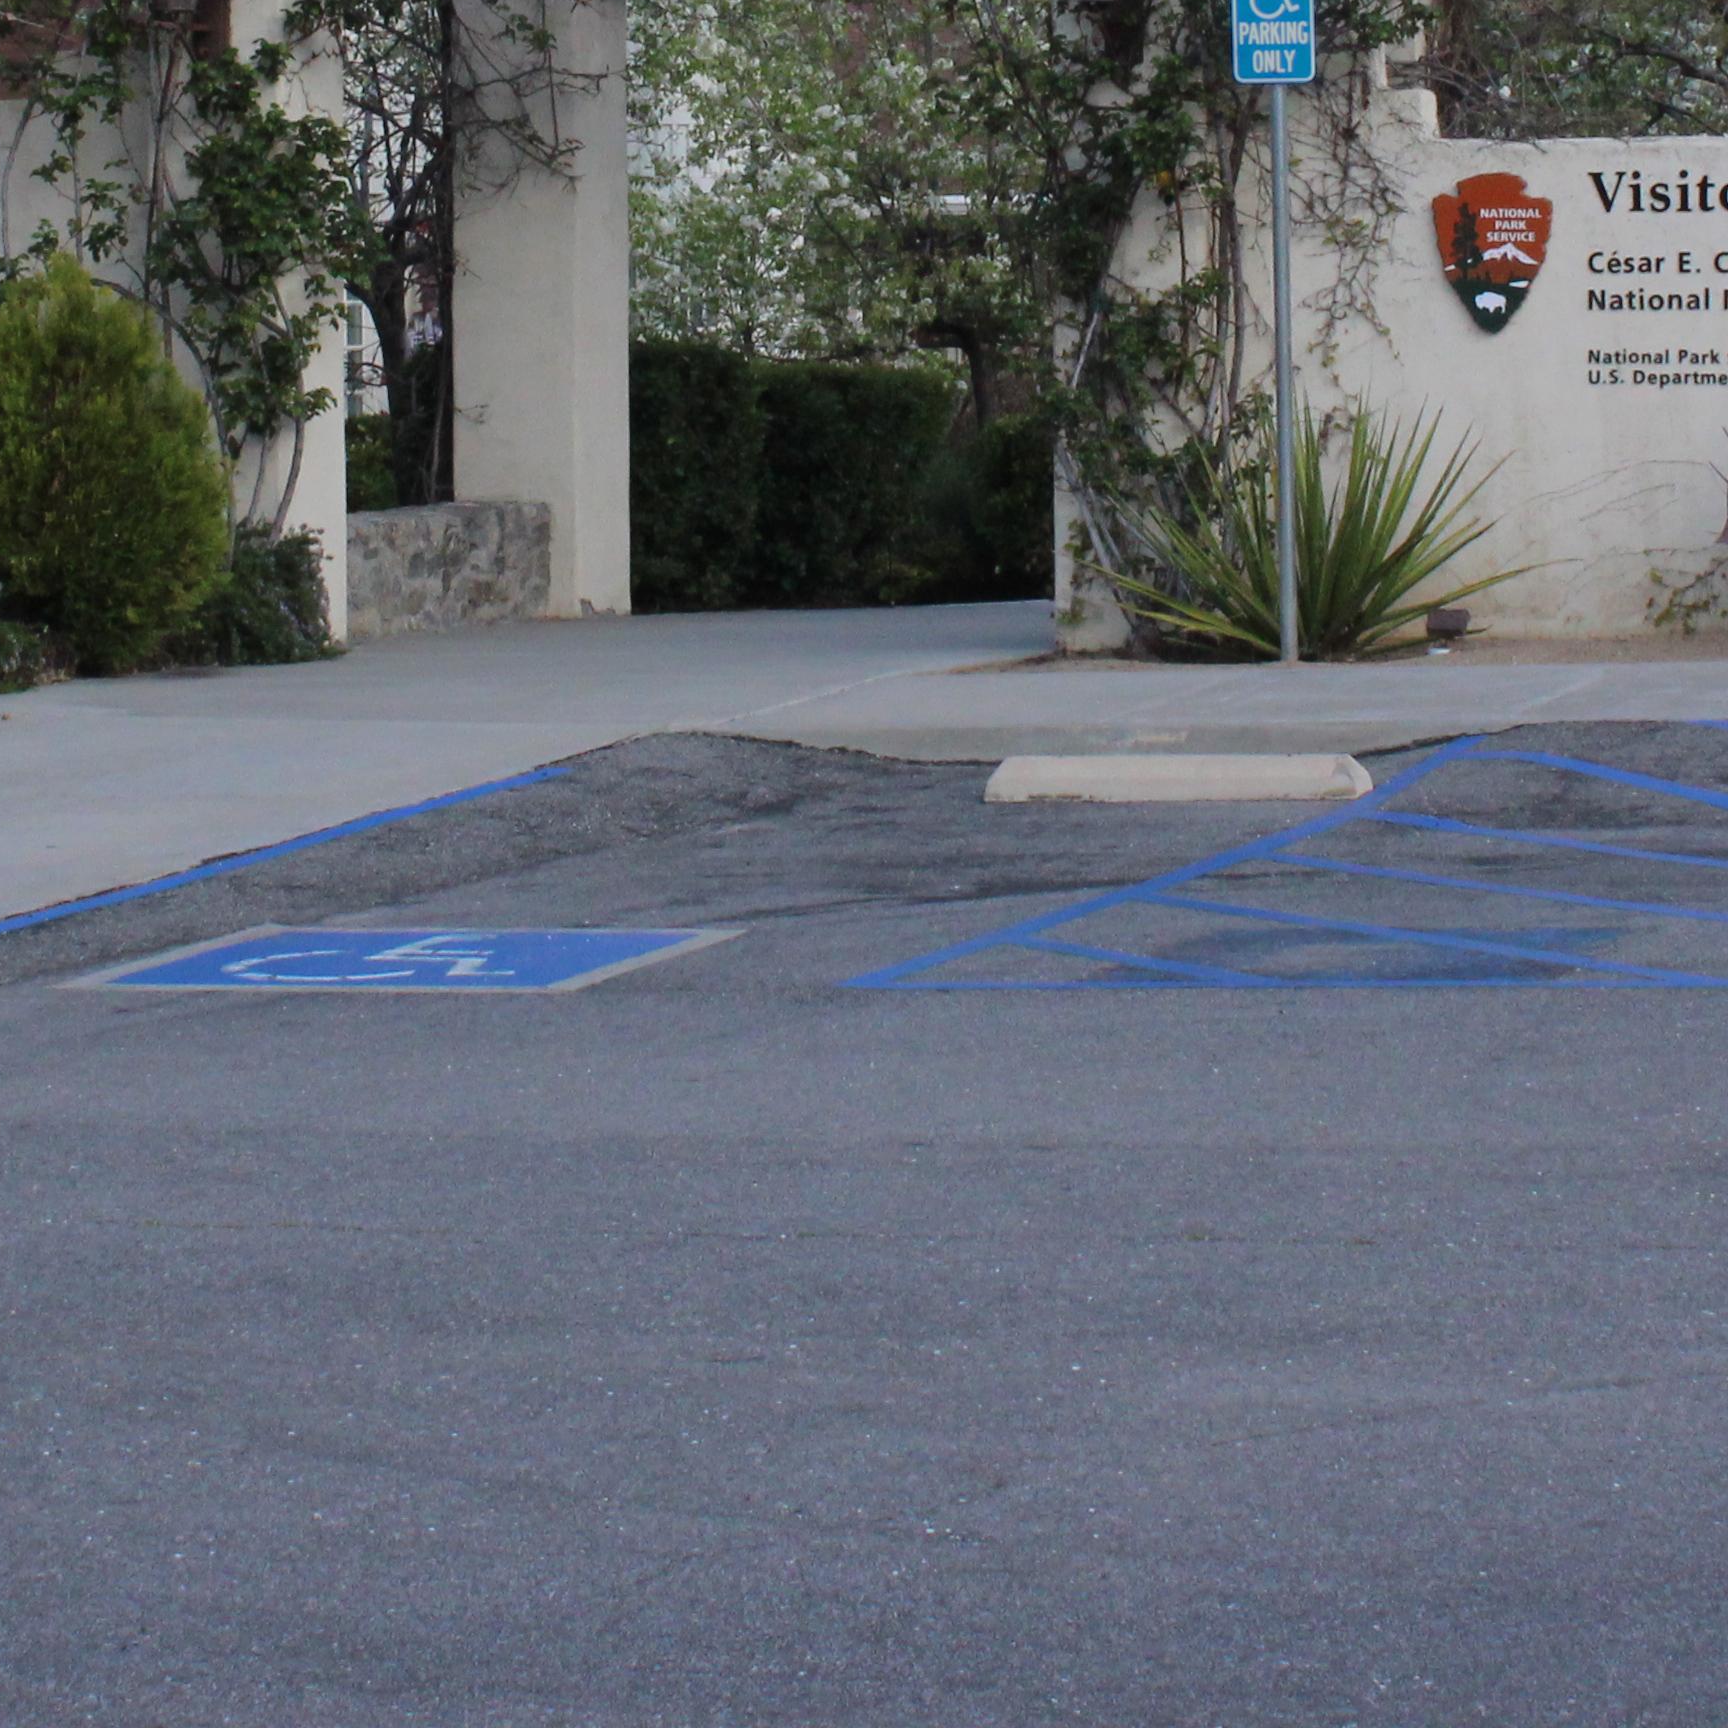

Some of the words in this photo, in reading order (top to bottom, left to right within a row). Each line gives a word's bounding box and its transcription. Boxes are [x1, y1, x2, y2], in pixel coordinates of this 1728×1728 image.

[1239, 21, 1308, 45] PARKING
[1252, 49, 1296, 74] ONLY
[1480, 208, 1542, 218] NATIONAL
[1495, 220, 1527, 229] PARK
[1486, 231, 1536, 242] SERVICE
[1587, 250, 1666, 274] César
[1678, 251, 1702, 274] E.
[1587, 287, 1710, 311] National
[1588, 349, 1670, 365] National
[1678, 349, 1720, 365] Park
[1588, 370, 1625, 385] U.S.
